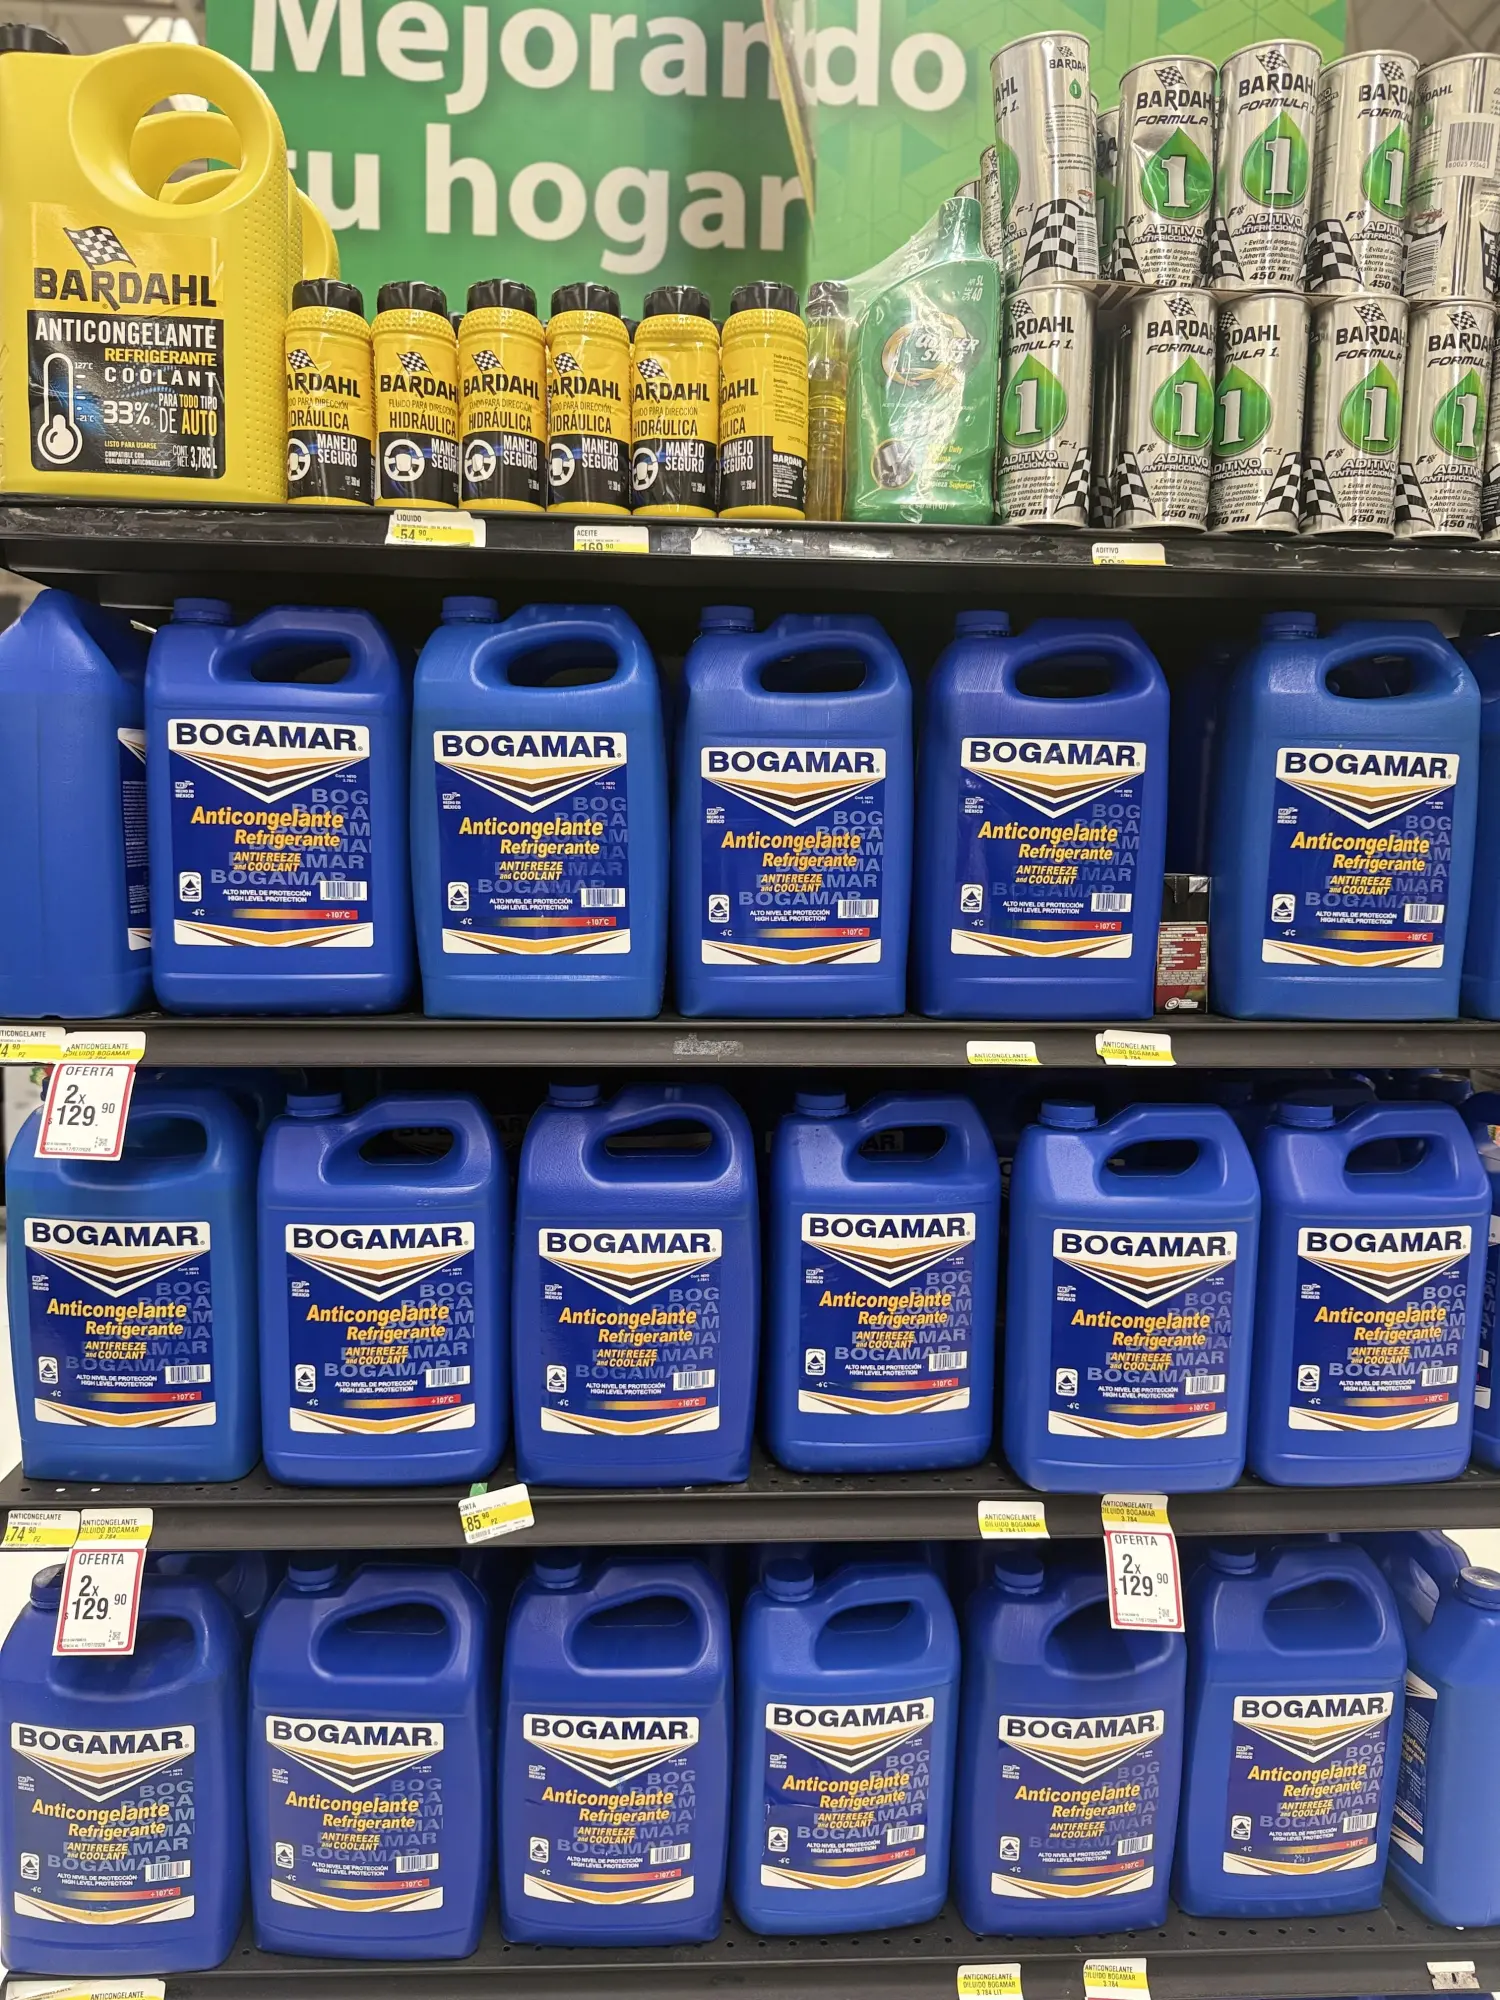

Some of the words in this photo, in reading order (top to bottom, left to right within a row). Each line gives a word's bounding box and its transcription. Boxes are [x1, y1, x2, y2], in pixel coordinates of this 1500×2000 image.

[250, 0, 967, 114] Mejorando
[1238, 97, 1309, 115] FORMULA
[1135, 114, 1209, 126] FORMULA
[426, 123, 806, 274] hogar
[1244, 212, 1302, 228] ADITIVO
[1144, 223, 1204, 237] ADITIVO
[1250, 271, 1275, 281] 450
[34, 267, 217, 311] BARDAHL
[35, 317, 217, 350] ANTICONGELANTE
[1006, 316, 1074, 339] ARDAHL
[104, 347, 217, 367] REFRIGERANTE
[1146, 343, 1213, 356] FORMULA
[1335, 349, 1402, 361] FORMULA
[104, 366, 217, 387] COOLANT
[463, 373, 540, 400] BARDAHL
[158, 393, 178, 408] PARA
[179, 393, 199, 409] TODO
[201, 395, 218, 410] TIPO
[103, 400, 150, 426] 33%
[159, 408, 177, 434] DE
[181, 409, 218, 437] AUTO
[468, 408, 532, 433] HIDRÁULICA
[389, 409, 457, 437] HIDRÁULICA
[104, 440, 120, 448] LISTO
[121, 441, 136, 449] PARA
[136, 442, 158, 450] USARSE
[317, 433, 357, 453] MANEJO
[503, 434, 538, 456] MANEJO
[581, 437, 619, 458] MANEJO
[665, 441, 705, 459] MANEJO
[130, 459, 171, 468] ANTICONGELANTE
[317, 449, 358, 468] SEGURO
[503, 451, 538, 472] SEGURO
[581, 454, 619, 472] SEGURO
[665, 457, 705, 474] SEGURO
[1002, 451, 1058, 467] ADITIVO
[1153, 453, 1209, 465] ADITIVO
[1341, 458, 1396, 471] ADITIVO
[396, 514, 422, 522] LIQUIDO
[1004, 508, 1027, 519] 450
[1029, 507, 1047, 517] ml
[1161, 510, 1186, 518] 450
[1348, 514, 1375, 523] 450
[175, 723, 356, 751] BOGAMAR
[441, 735, 615, 758] BOGAMAR
[708, 751, 874, 773] BOGAMAR
[970, 741, 1135, 766] BOGAMAR
[1285, 752, 1447, 778] BOGAMAR
[192, 805, 344, 830] Anticongelante
[459, 816, 603, 839] Anticongelante
[979, 820, 1118, 845] Anticongelante
[235, 829, 339, 850] Refrigerante
[501, 839, 599, 858] Refrigerante
[722, 830, 861, 853] Anticongelante
[1292, 830, 1430, 855] Anticongelante
[235, 852, 301, 863] ANTIFREEZE
[763, 852, 856, 871] Refrigerante
[1019, 843, 1112, 863] Refrigerante
[247, 861, 300, 871] COOLANT
[500, 861, 563, 871] ANTIFREEZE
[1017, 865, 1078, 876] ANTIFREEZE
[1333, 854, 1425, 874] Refrigerante
[513, 870, 562, 880] COOLANT
[1028, 874, 1077, 884] COOLANT
[1103, 1041, 1156, 1051] ANTICONGELANTE
[66, 1066, 114, 1077] OFERTA
[101, 1103, 115, 1114] 90
[31, 1222, 198, 1247] BOGAMAR
[810, 1217, 965, 1238] BOGAMAR
[293, 1226, 462, 1249] BOGAMAR
[546, 1232, 710, 1254] BOGAMAR
[1061, 1233, 1226, 1257] BOGAMAR
[1307, 1231, 1462, 1253] BOGAMAR
[47, 1297, 187, 1322] Anticongelante
[820, 1289, 952, 1312] Anticongelante
[307, 1303, 449, 1326] Anticongelante
[559, 1306, 697, 1329] Anticongelante
[858, 1311, 947, 1329] Refrigerante
[1072, 1308, 1210, 1333] Anticongelante
[1315, 1305, 1446, 1327] Anticongelante
[86, 1321, 183, 1339] Refrigerante
[347, 1325, 445, 1344] Refrigerante
[599, 1329, 692, 1347] Refrigerante
[1355, 1326, 1441, 1344] Refrigerante
[347, 1346, 408, 1356] ANTIFREEZE
[1113, 1332, 1205, 1351] Refrigerante
[358, 1354, 408, 1364] COOLANT
[1112, 1353, 1172, 1363] ANTIFREEZE
[1123, 1361, 1171, 1370] COOLANT
[460, 1502, 477, 1511] CINTA
[1102, 1500, 1153, 1509] ANTICONGELANTE
[1126, 1508, 1156, 1517] BOGAMAR
[80, 1526, 106, 1534] DILUIDO
[1115, 1534, 1158, 1546] OFERTA
[78, 1553, 125, 1565] OFERTA
[1157, 1573, 1169, 1585] 90
[114, 1594, 127, 1605] 90
[773, 1702, 925, 1728] BOGAMAR
[1241, 1697, 1385, 1718] BOGAMAR
[273, 1720, 432, 1746] BOGAMAR
[531, 1718, 688, 1740] BOGAMAR
[1006, 1715, 1155, 1739] BOGAMAR
[18, 1727, 182, 1754] BOGAMAR
[1248, 1762, 1366, 1784] Anticongelante
[783, 1772, 909, 1795] Anticongelante
[1284, 1780, 1361, 1799] Refrigerante
[286, 1790, 419, 1816] Anticongelante
[542, 1785, 674, 1810] Anticongelante
[820, 1790, 905, 1810] Refrigerante
[1015, 1783, 1140, 1805] Anticongelante
[32, 1798, 169, 1825] Anticongelante
[1052, 1801, 1136, 1820] Refrigerante
[1282, 1799, 1333, 1810] ANTIFREEZE
[1291, 1806, 1332, 1816] COOLANT
[323, 1813, 414, 1832] Refrigerante
[579, 1808, 669, 1826] Refrigerante
[69, 1822, 165, 1841] Refrigerante
[322, 1833, 380, 1843] ANTIFREEZE
[333, 1841, 379, 1850] COOLANT
[1085, 1964, 1133, 1973] ANTICONGELANTE
[90, 1991, 144, 1999] ANTICONGELANTE
